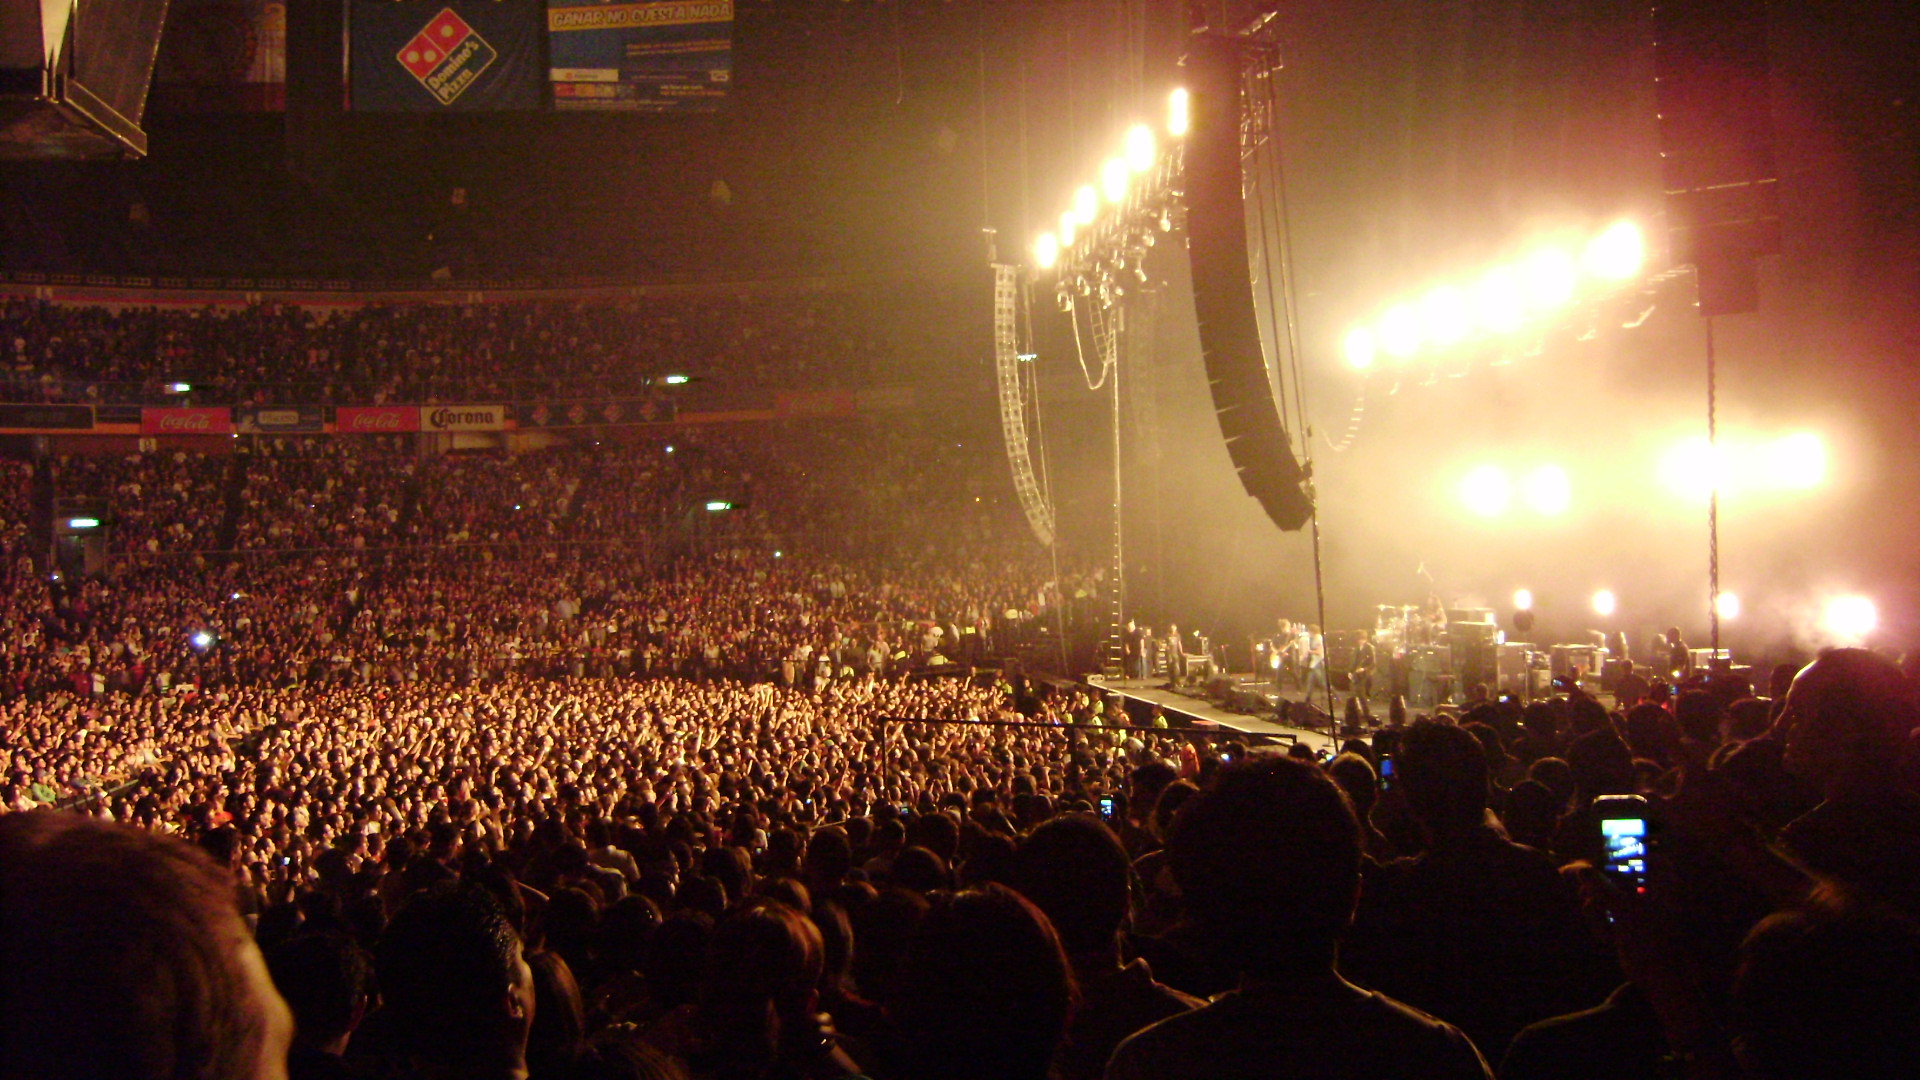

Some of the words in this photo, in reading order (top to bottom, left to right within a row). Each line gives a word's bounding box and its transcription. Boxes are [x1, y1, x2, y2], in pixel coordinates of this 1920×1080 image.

[553, 11, 603, 27] GANAR
[607, 10, 627, 24] NO
[631, 6, 687, 22] CUESTA
[689, 3, 730, 18] NADA
[427, 41, 478, 90] Domino's
[437, 69, 474, 99] Pizza
[430, 408, 494, 430] Corona
